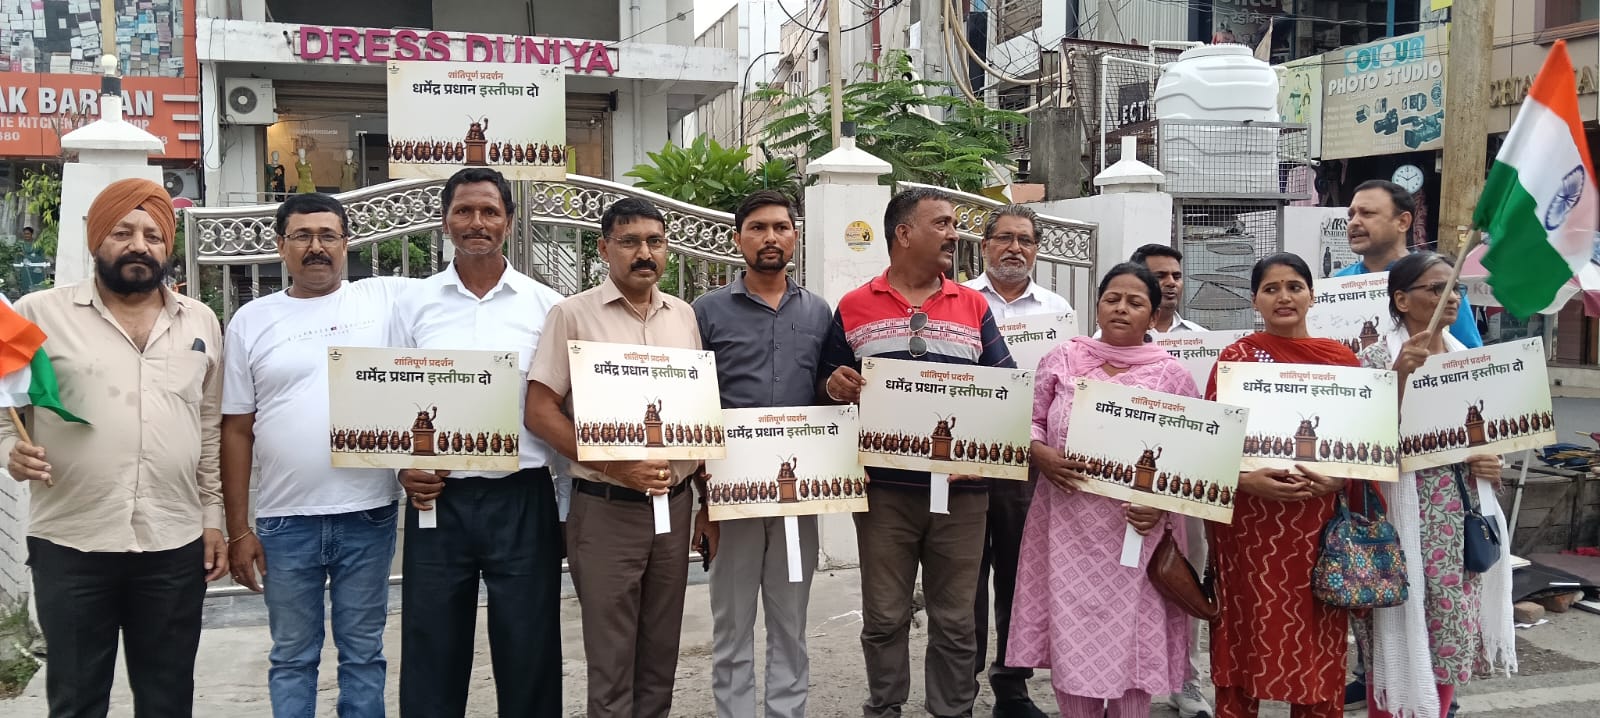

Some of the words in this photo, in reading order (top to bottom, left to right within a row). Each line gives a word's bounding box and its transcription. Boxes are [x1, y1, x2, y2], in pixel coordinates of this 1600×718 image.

[299, 26, 451, 62] DRESS
[466, 34, 615, 75] DUNIYA
[1345, 37, 1424, 73] COLOUR
[448, 71, 478, 81] शांतिपूर्ण
[479, 71, 504, 80] प्रदर्शन
[1328, 71, 1379, 96] PHOTO
[1384, 60, 1443, 88] STUDIO
[413, 80, 441, 95] धर्मेंद्र
[444, 84, 476, 95] प्रधान
[479, 82, 523, 98] इस्तीफा
[526, 82, 539, 97] दो
[38, 87, 154, 116] BARAN
[1338, 290, 1366, 301] प्रधान
[1007, 331, 1043, 346] इस्तीफा
[1045, 328, 1057, 340] दो
[1183, 337, 1203, 346] प्रदर्शन
[651, 353, 669, 362] प्रदर्शन
[1183, 346, 1220, 360] इस्तीफा
[1442, 357, 1469, 369] शांतिपूर्ण
[1470, 354, 1491, 365] प्रदर्शन
[394, 356, 427, 368] शांतिपूर्ण
[429, 357, 454, 367] प्रदर्शन
[594, 360, 619, 376] धर्मेंद्र
[621, 365, 649, 376] प्रधान
[651, 364, 686, 380] इस्तीफा
[688, 366, 698, 379] दो
[356, 367, 386, 383] धर्मेंद्र
[389, 370, 424, 383] प्रधान
[427, 369, 475, 385] इस्तीफा
[478, 370, 492, 385] दो
[921, 370, 950, 382] शांतिपूर्ण
[951, 371, 975, 382] प्रदर्शन
[1279, 371, 1310, 382] शांतिपूर्ण
[1312, 372, 1336, 381] प्रदर्शन
[1412, 374, 1438, 389] धर्मेंद्र
[1440, 370, 1469, 385] प्रधान
[1471, 363, 1510, 380] इस्तीफा
[1513, 358, 1524, 371] दो
[885, 377, 912, 393] धर्मेंद्र
[915, 381, 946, 394] प्रधान
[949, 383, 992, 399] इस्तीफा
[995, 386, 1008, 400] दो
[1243, 379, 1271, 393] धर्मेंद्र
[1274, 383, 1307, 394] प्रधान
[1310, 382, 1355, 397] इस्तीफा
[1359, 385, 1372, 399] दो
[1131, 396, 1160, 409] शांतिपूर्ण
[1162, 401, 1186, 413] प्रदर्शन
[787, 413, 807, 422] प्रदर्शन
[1095, 400, 1122, 418] धर्मेंद्र
[1124, 406, 1156, 423] प्रधान
[1158, 413, 1202, 432] इस्तीफा
[1206, 420, 1220, 435] दो
[727, 425, 752, 439] धर्मेंद्र
[755, 427, 784, 438] प्रधान
[786, 423, 825, 439] इस्तीफा
[827, 422, 839, 435] दो
